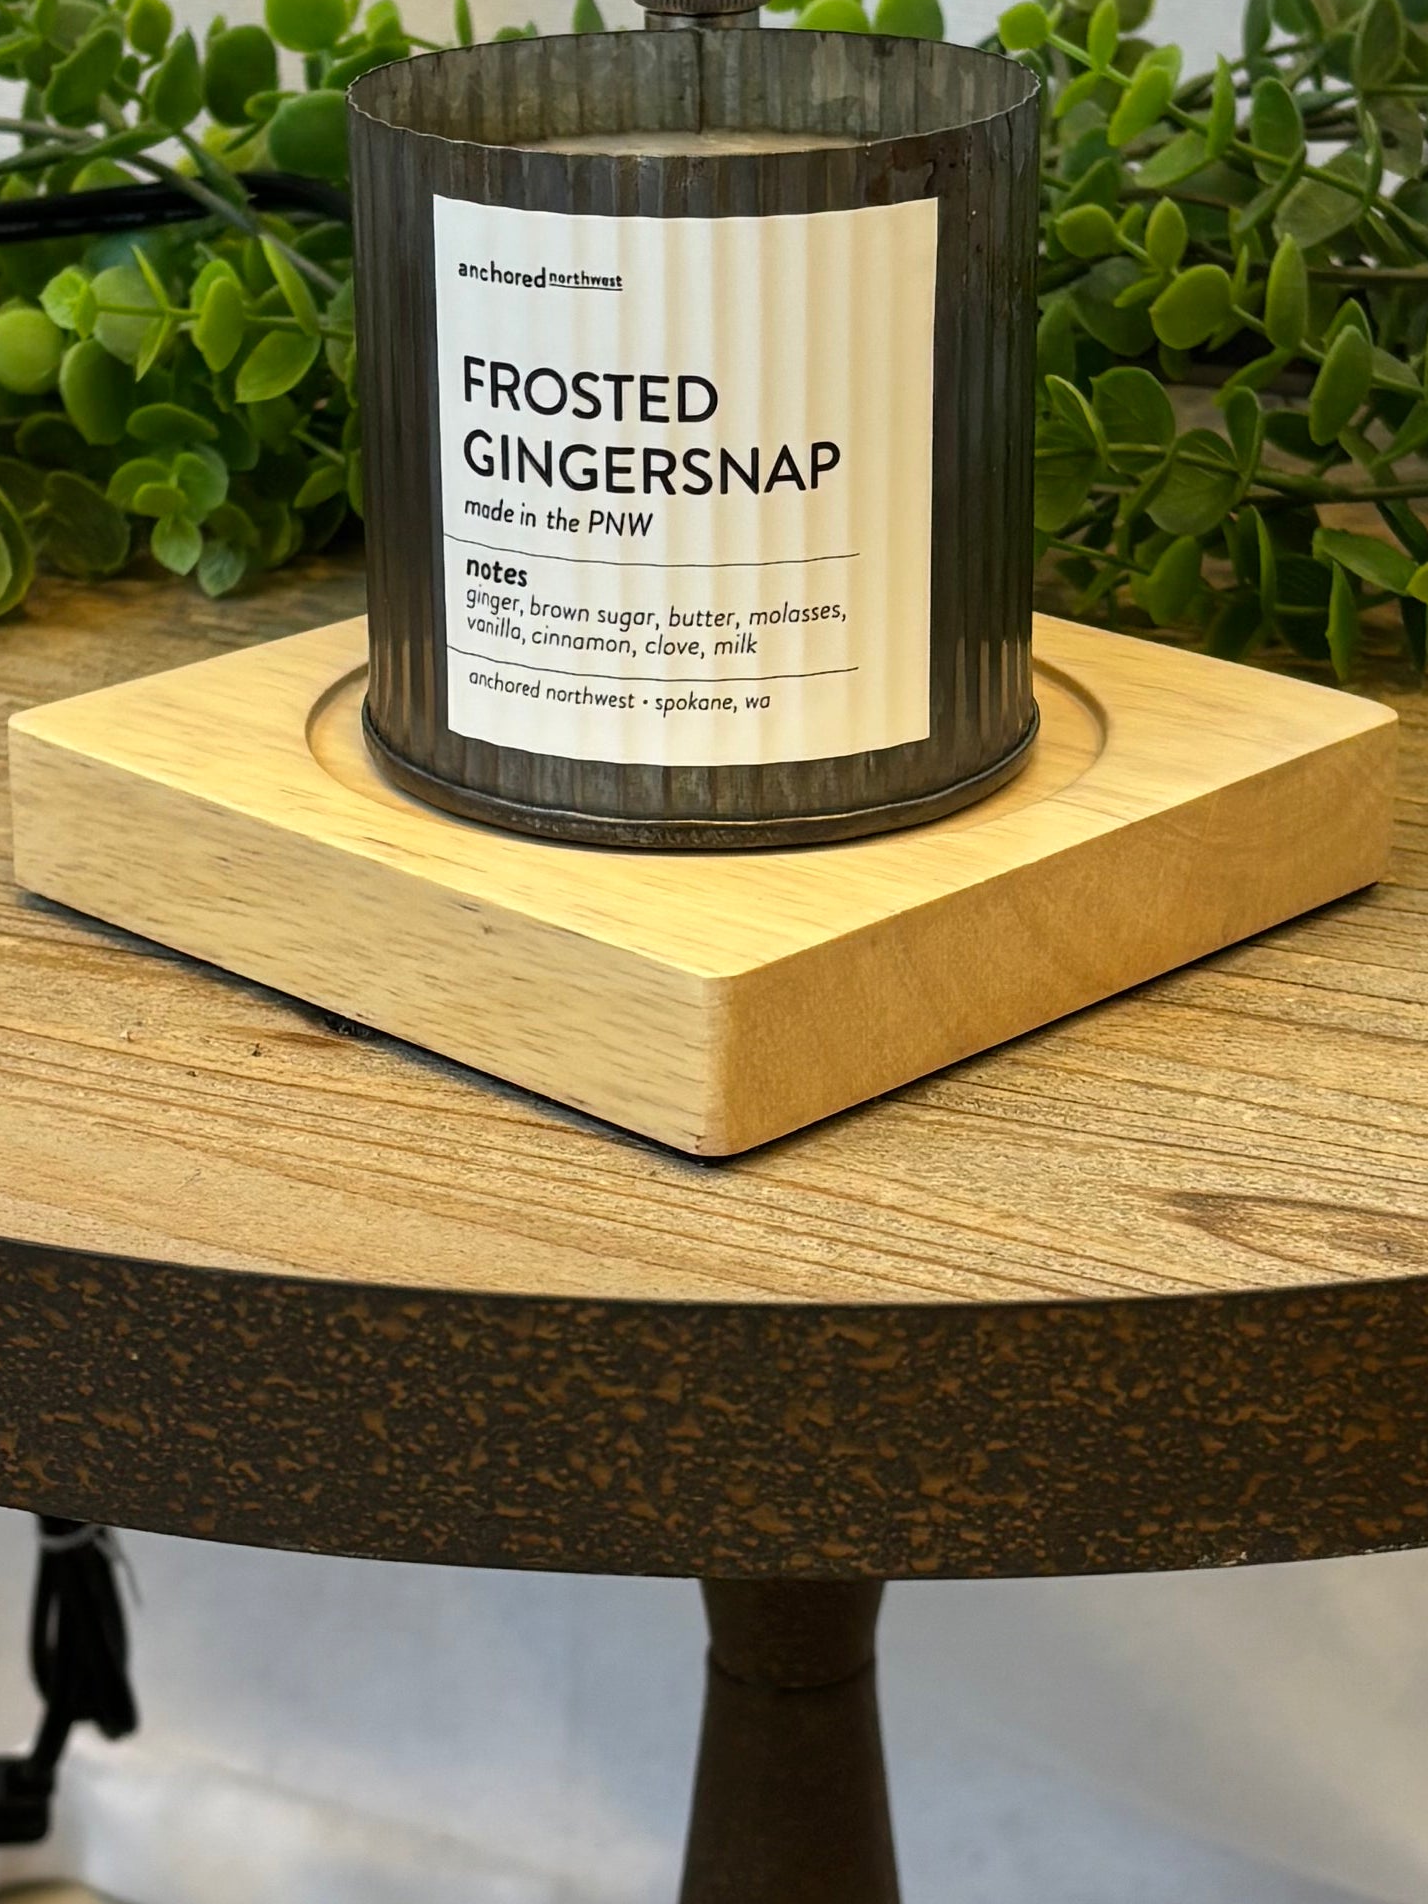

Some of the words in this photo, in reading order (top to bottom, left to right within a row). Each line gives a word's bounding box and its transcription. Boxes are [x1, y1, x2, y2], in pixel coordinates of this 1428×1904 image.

[463, 354, 719, 424] FROSTED
[463, 428, 841, 496] GINGERSNAP
[464, 498, 515, 524] made
[519, 501, 537, 528] in
[546, 506, 581, 534] the
[587, 509, 654, 537] PNW
[465, 558, 528, 588] notes
[466, 583, 524, 617] ginger,
[529, 594, 590, 623] brown
[597, 609, 660, 633] sugar,
[668, 604, 741, 631] butter,
[748, 600, 847, 626] molasses,
[467, 616, 526, 646] vanilla,
[531, 624, 637, 659] cinnamon,
[644, 633, 705, 660] clove,
[713, 631, 758, 656] milk
[468, 671, 541, 699] anchored
[546, 685, 636, 709] northwest
[654, 690, 738, 719] spokane,
[745, 695, 771, 710] wa
